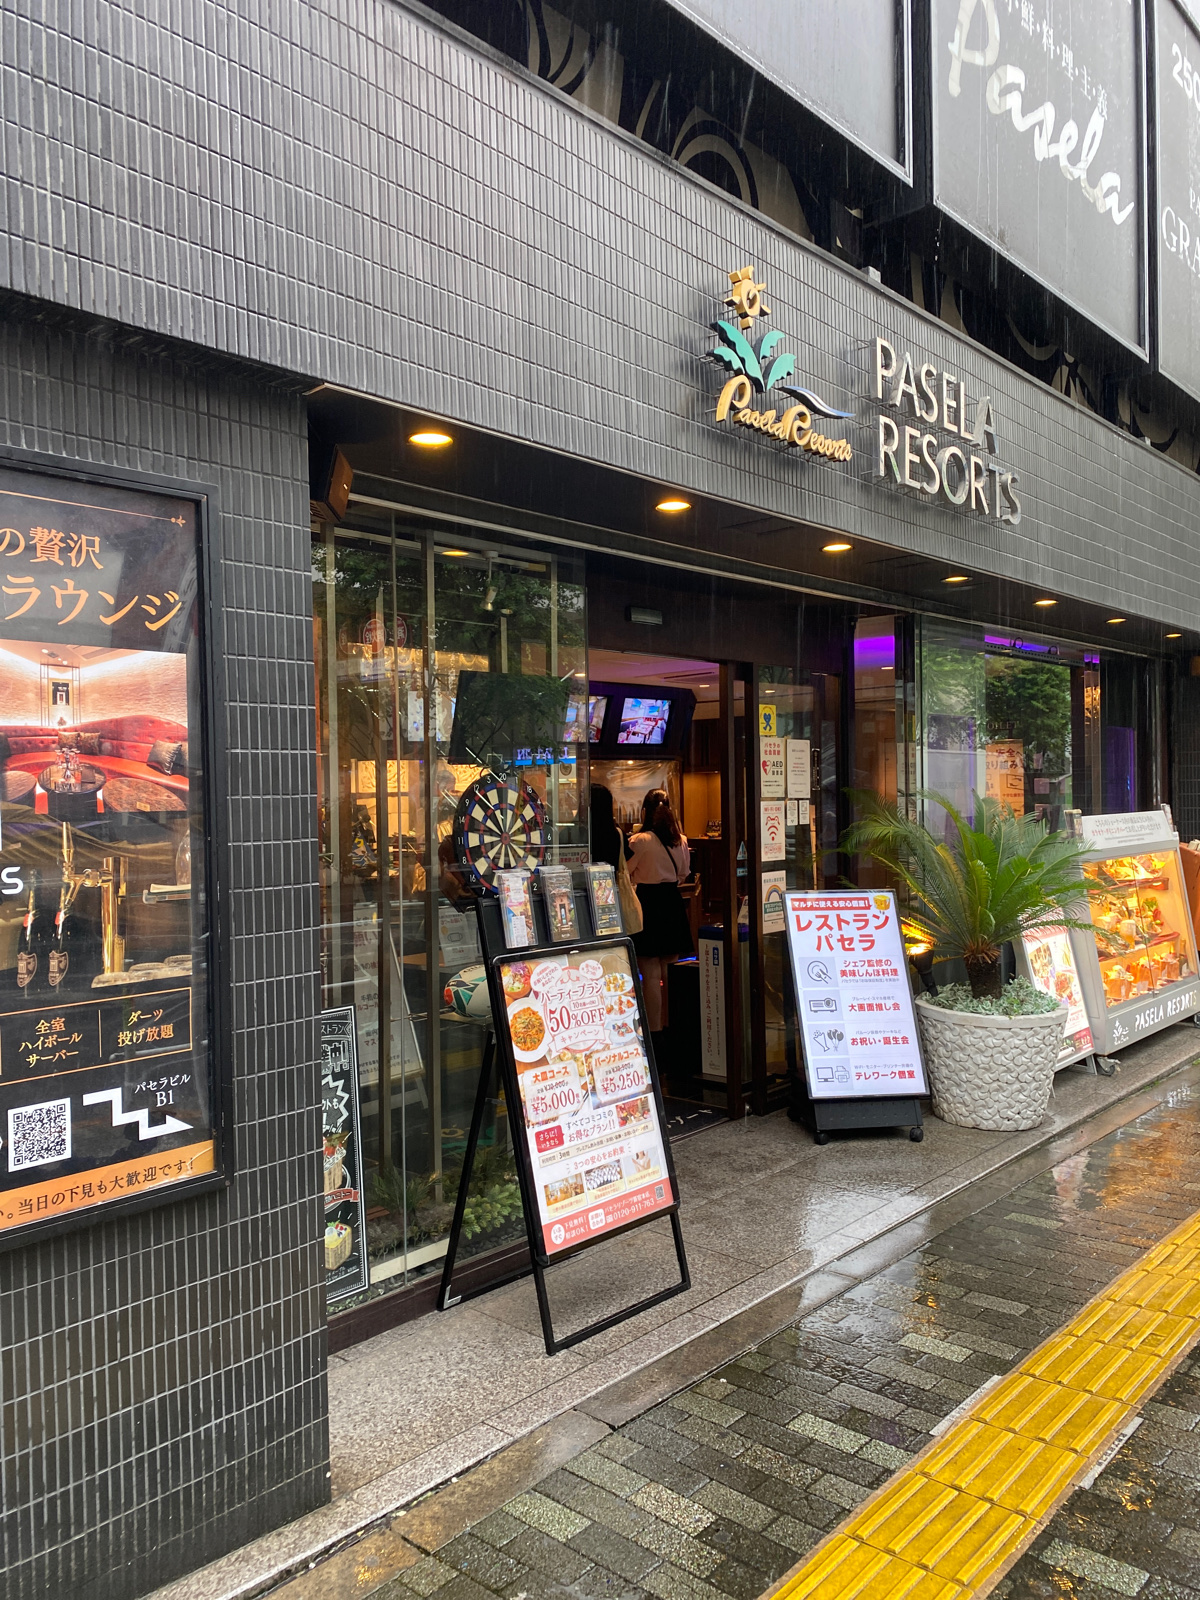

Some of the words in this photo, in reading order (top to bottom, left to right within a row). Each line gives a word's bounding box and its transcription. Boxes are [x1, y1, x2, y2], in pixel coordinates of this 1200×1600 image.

[869, 337, 998, 454] PASELA
[873, 415, 1021, 525] RESORTS
[2, 574, 182, 631] ラウンジ
[499, 773, 507, 781] 20
[473, 784, 480, 792] 12
[526, 785, 533, 793] 18
[457, 837, 464, 845] 11
[547, 833, 551, 841] 6
[545, 853, 551, 861] 10
[469, 875, 476, 883] 16
[533, 883, 538, 891] 2
[482, 887, 486, 895] 7
[796, 914, 889, 932] レストラン
[816, 934, 875, 952] パセラ
[843, 959, 892, 968] シェフ監修の
[840, 968, 898, 977] 美味しんぼ料理
[541, 982, 602, 1004] パーティープラン
[848, 1002, 900, 1012] 大画面推し会
[36, 1017, 65, 1034] 全室
[128, 1009, 163, 1026] ダーツ
[548, 1006, 605, 1032] 50%OFF
[1135, 1004, 1164, 1032] PASELA
[19, 1033, 82, 1051] ハイボール
[118, 1024, 174, 1047] 投げ放題
[561, 1028, 600, 1044] キャンペーン
[850, 1036, 909, 1046] お祝い・誕生会
[26, 1052, 79, 1067] サーバー
[595, 1048, 640, 1067] パーソナルコース
[135, 1074, 190, 1093] パセラビル
[602, 1071, 640, 1094] ¥5,250
[855, 1070, 915, 1080] テレワーク個室
[156, 1090, 174, 1107] B1
[531, 1088, 575, 1115] ¥5,000
[566, 1110, 613, 1130] すべてコミコミの
